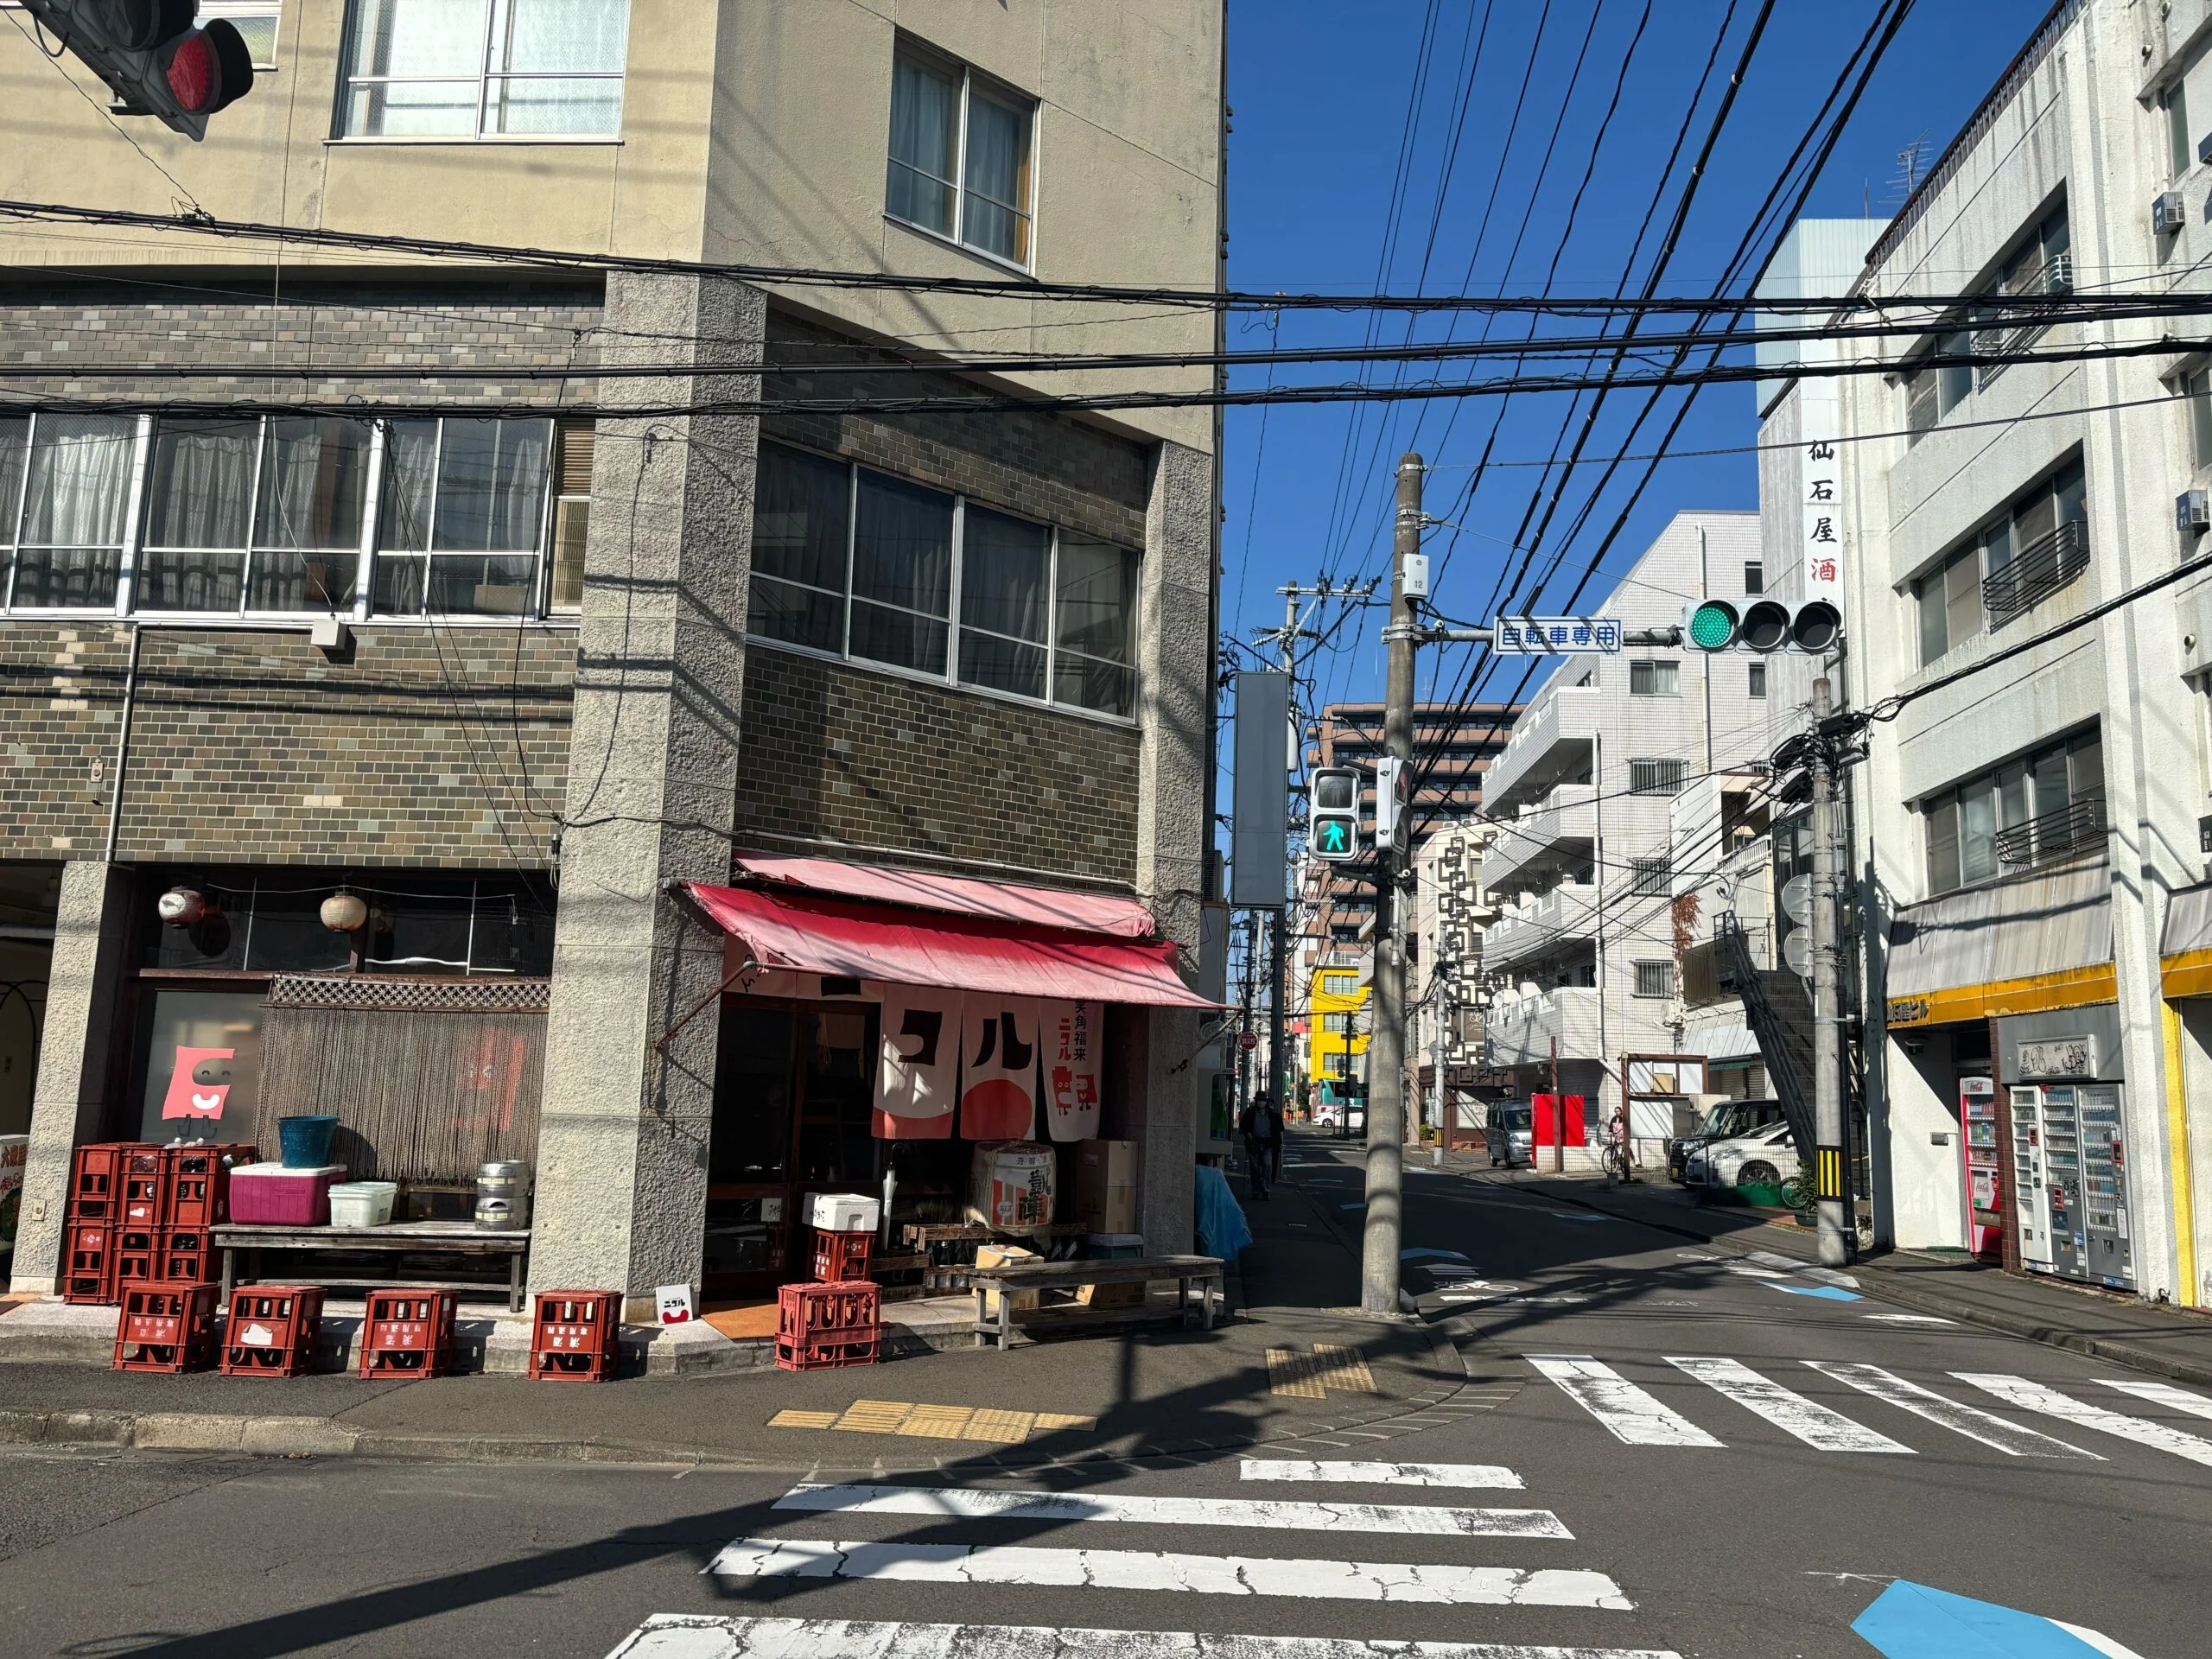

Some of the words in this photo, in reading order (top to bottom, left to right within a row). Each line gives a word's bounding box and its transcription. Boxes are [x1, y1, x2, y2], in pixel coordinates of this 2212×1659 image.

[1808, 440, 1837, 602] 仙石屋酒
[1502, 626, 1615, 646] 自転車専用
[1058, 1018, 1071, 1061] ニコル
[664, 1299, 685, 1308] ニコル
